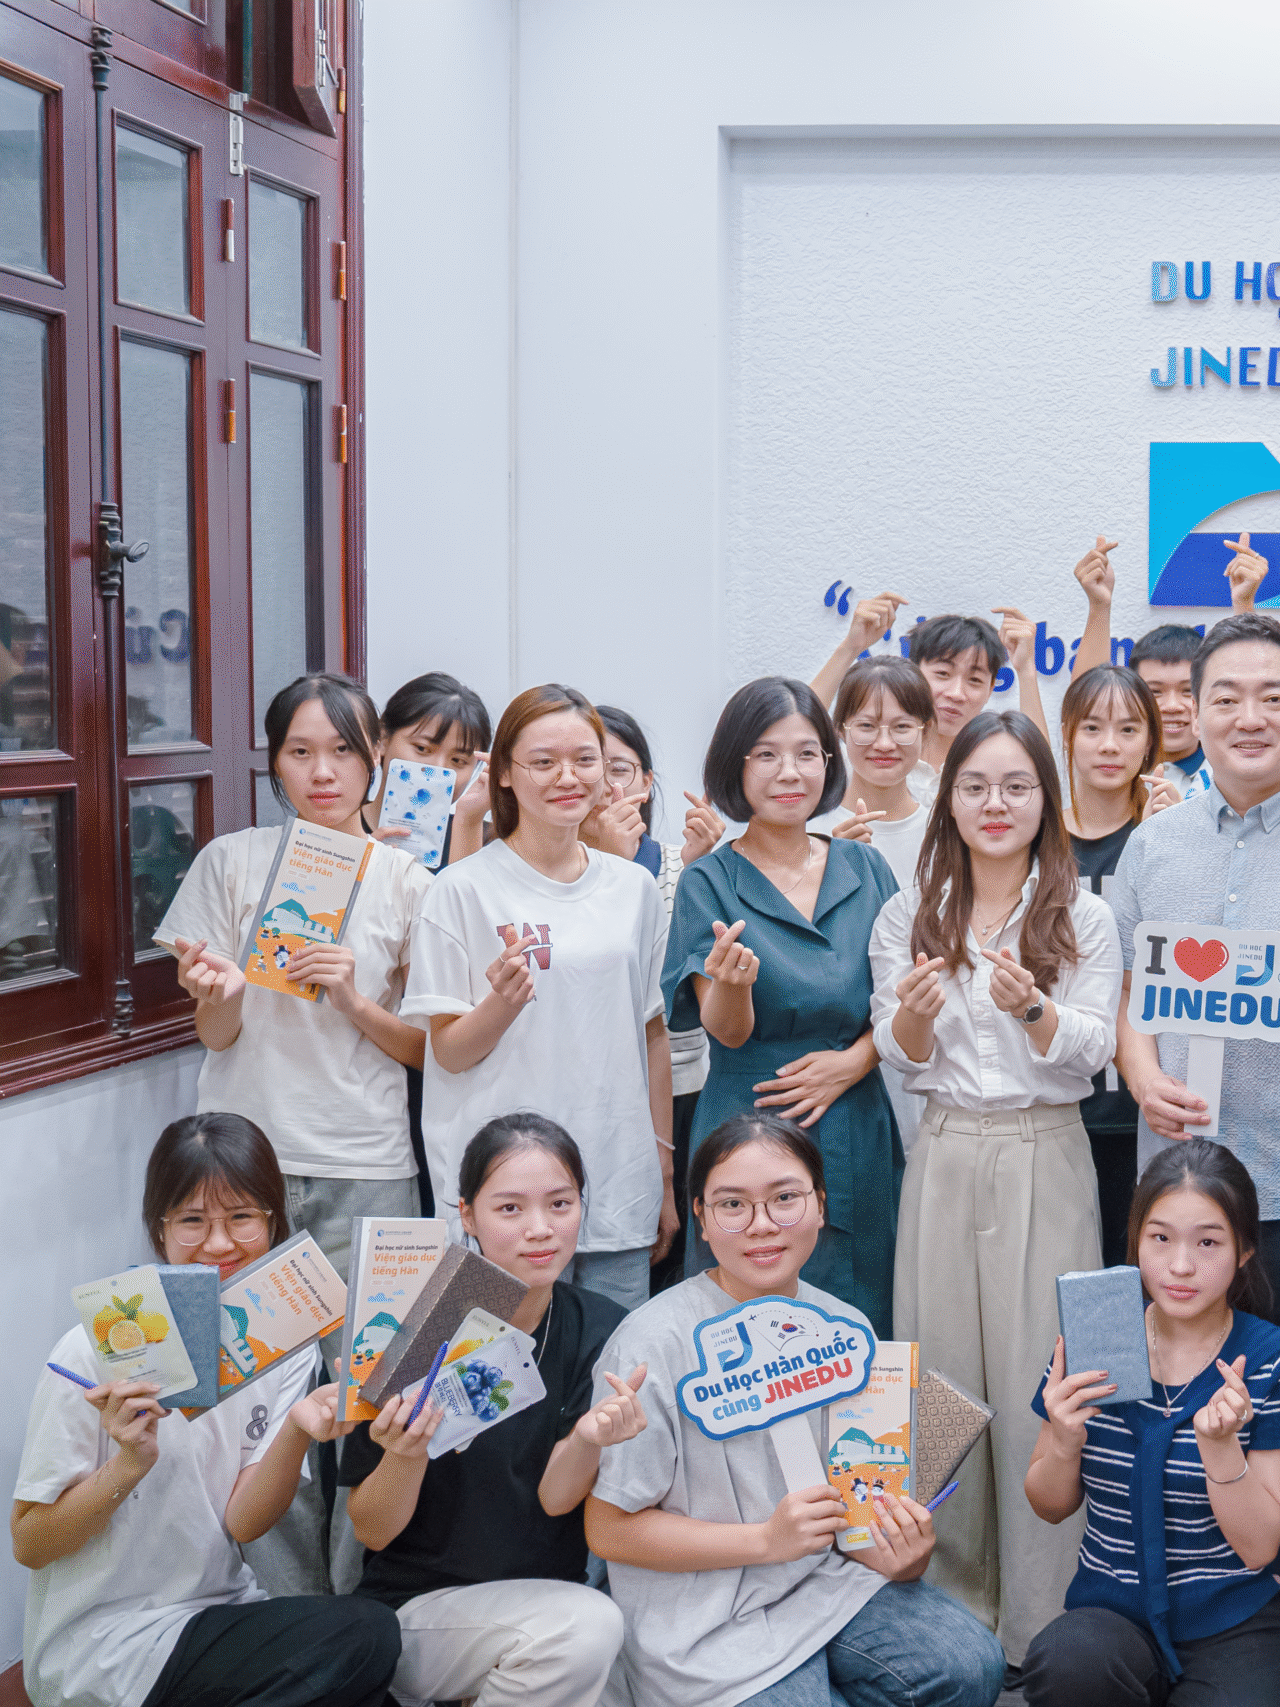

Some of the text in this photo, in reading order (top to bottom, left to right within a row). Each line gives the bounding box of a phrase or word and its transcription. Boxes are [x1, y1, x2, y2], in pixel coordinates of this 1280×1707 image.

[1151, 260, 1212, 302] DU
[289, 857, 313, 873] tiếng
[314, 865, 333, 878] Hàn
[293, 847, 353, 872] Viện giáo dục
[1145, 934, 1168, 976] I
[372, 1265, 419, 1278] tiếng Hàn
[374, 1252, 437, 1264] Viện giáo dục
[268, 1272, 289, 1298] tiếng
[286, 1295, 302, 1316] Hàn
[281, 1264, 298, 1286] Viện
[293, 1286, 312, 1306] giáo
[693, 1329, 858, 1403] Du Học Hàn Quốc
[885, 1374, 903, 1385] dục
[712, 1357, 853, 1421] cùng JINEDU
